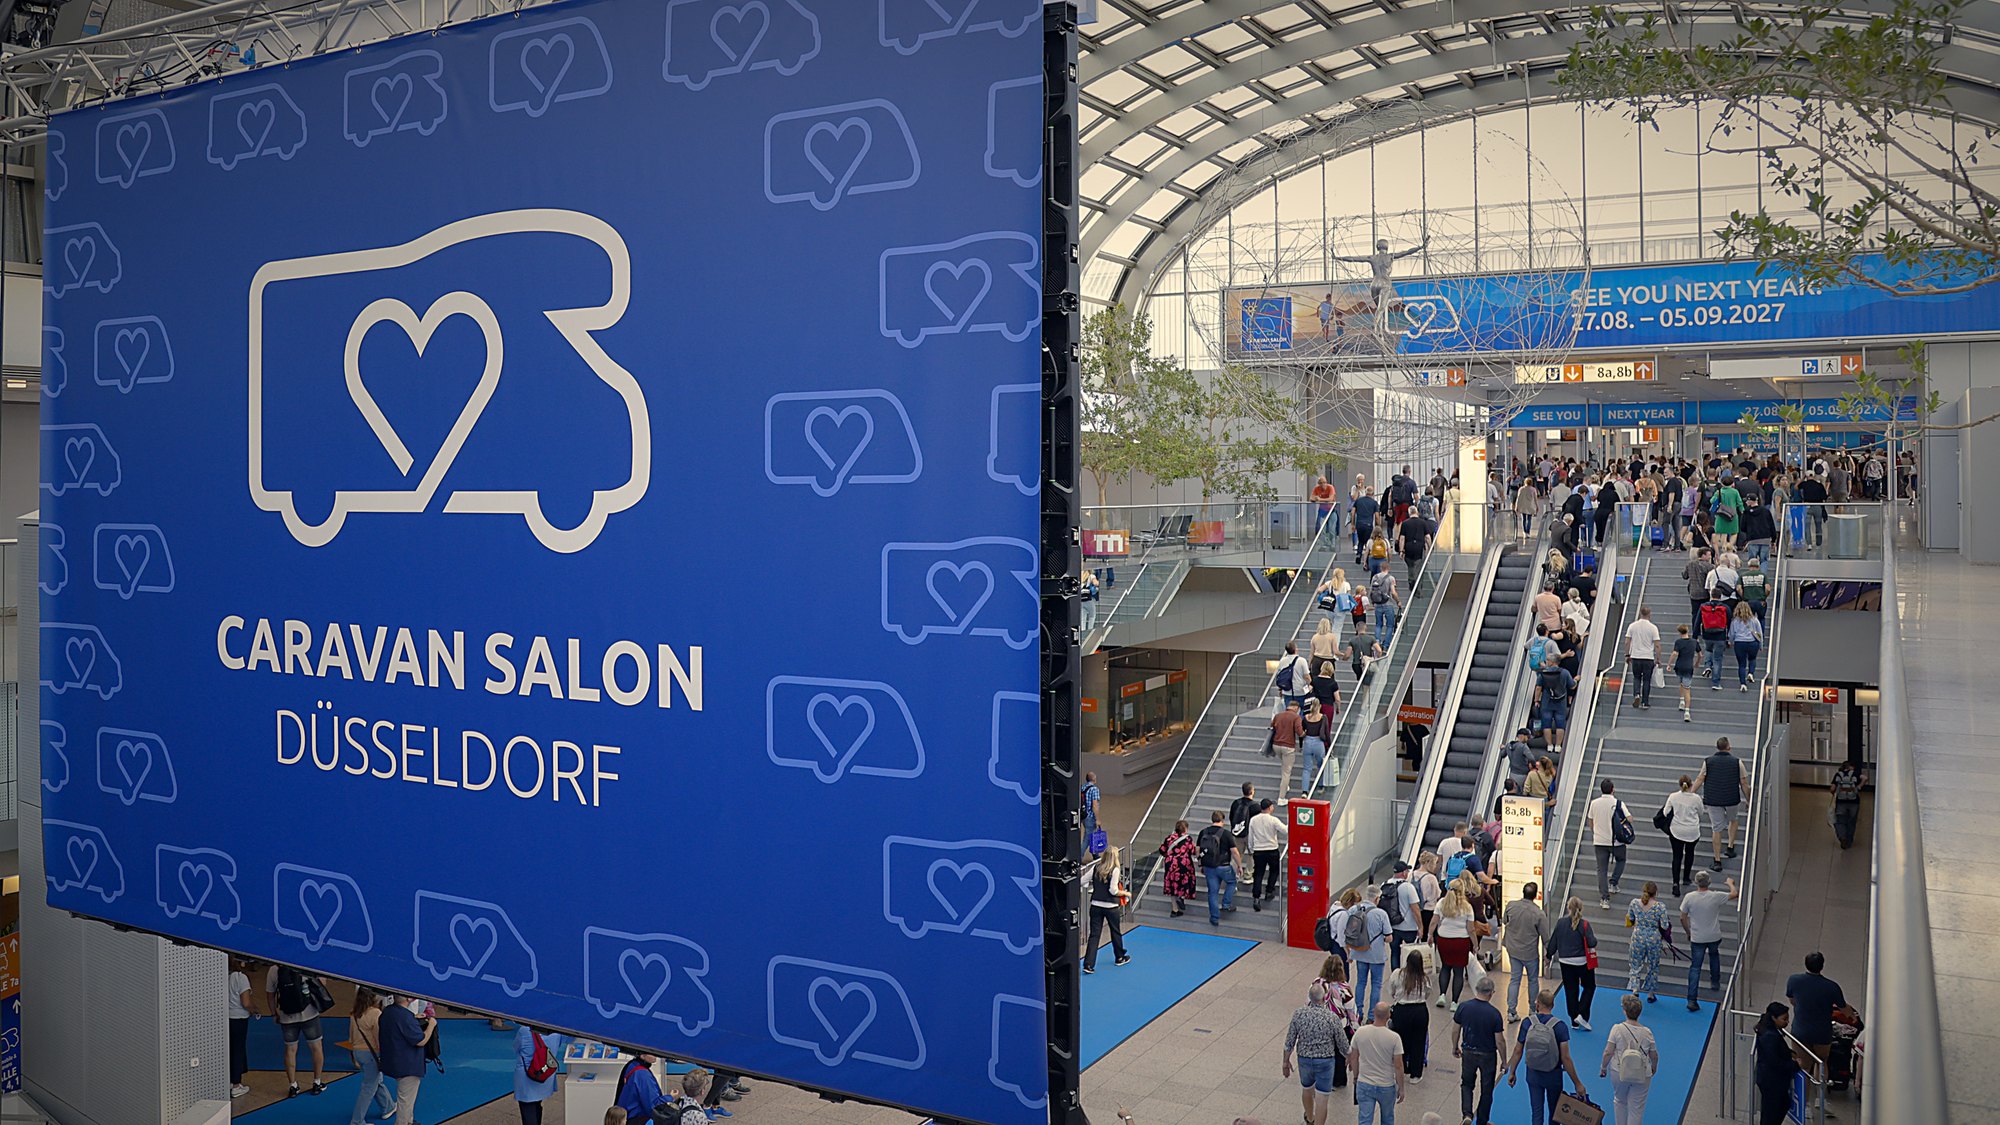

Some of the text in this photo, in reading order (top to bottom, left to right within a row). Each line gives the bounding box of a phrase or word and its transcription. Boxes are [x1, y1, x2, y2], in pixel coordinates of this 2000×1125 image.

[1570, 287, 1612, 307] SEE
[1617, 284, 1667, 305] YOU
[1675, 280, 1741, 302] NEXT
[1659, 303, 1786, 328] 05.09.2027
[1597, 365, 1632, 379] 8a,8b
[1532, 410, 1581, 421] SEE YOU
[1608, 408, 1675, 419] NEXT YEAR
[1745, 406, 1778, 417] 27.08
[1808, 404, 1879, 417] 05.092027
[216, 614, 703, 712] CARAVAN SALON
[1399, 710, 1435, 720] egistration
[276, 700, 622, 808] DÜSSELDORF
[1504, 806, 1532, 817] 8a,8b
[1, 1066, 17, 1083] LLE
